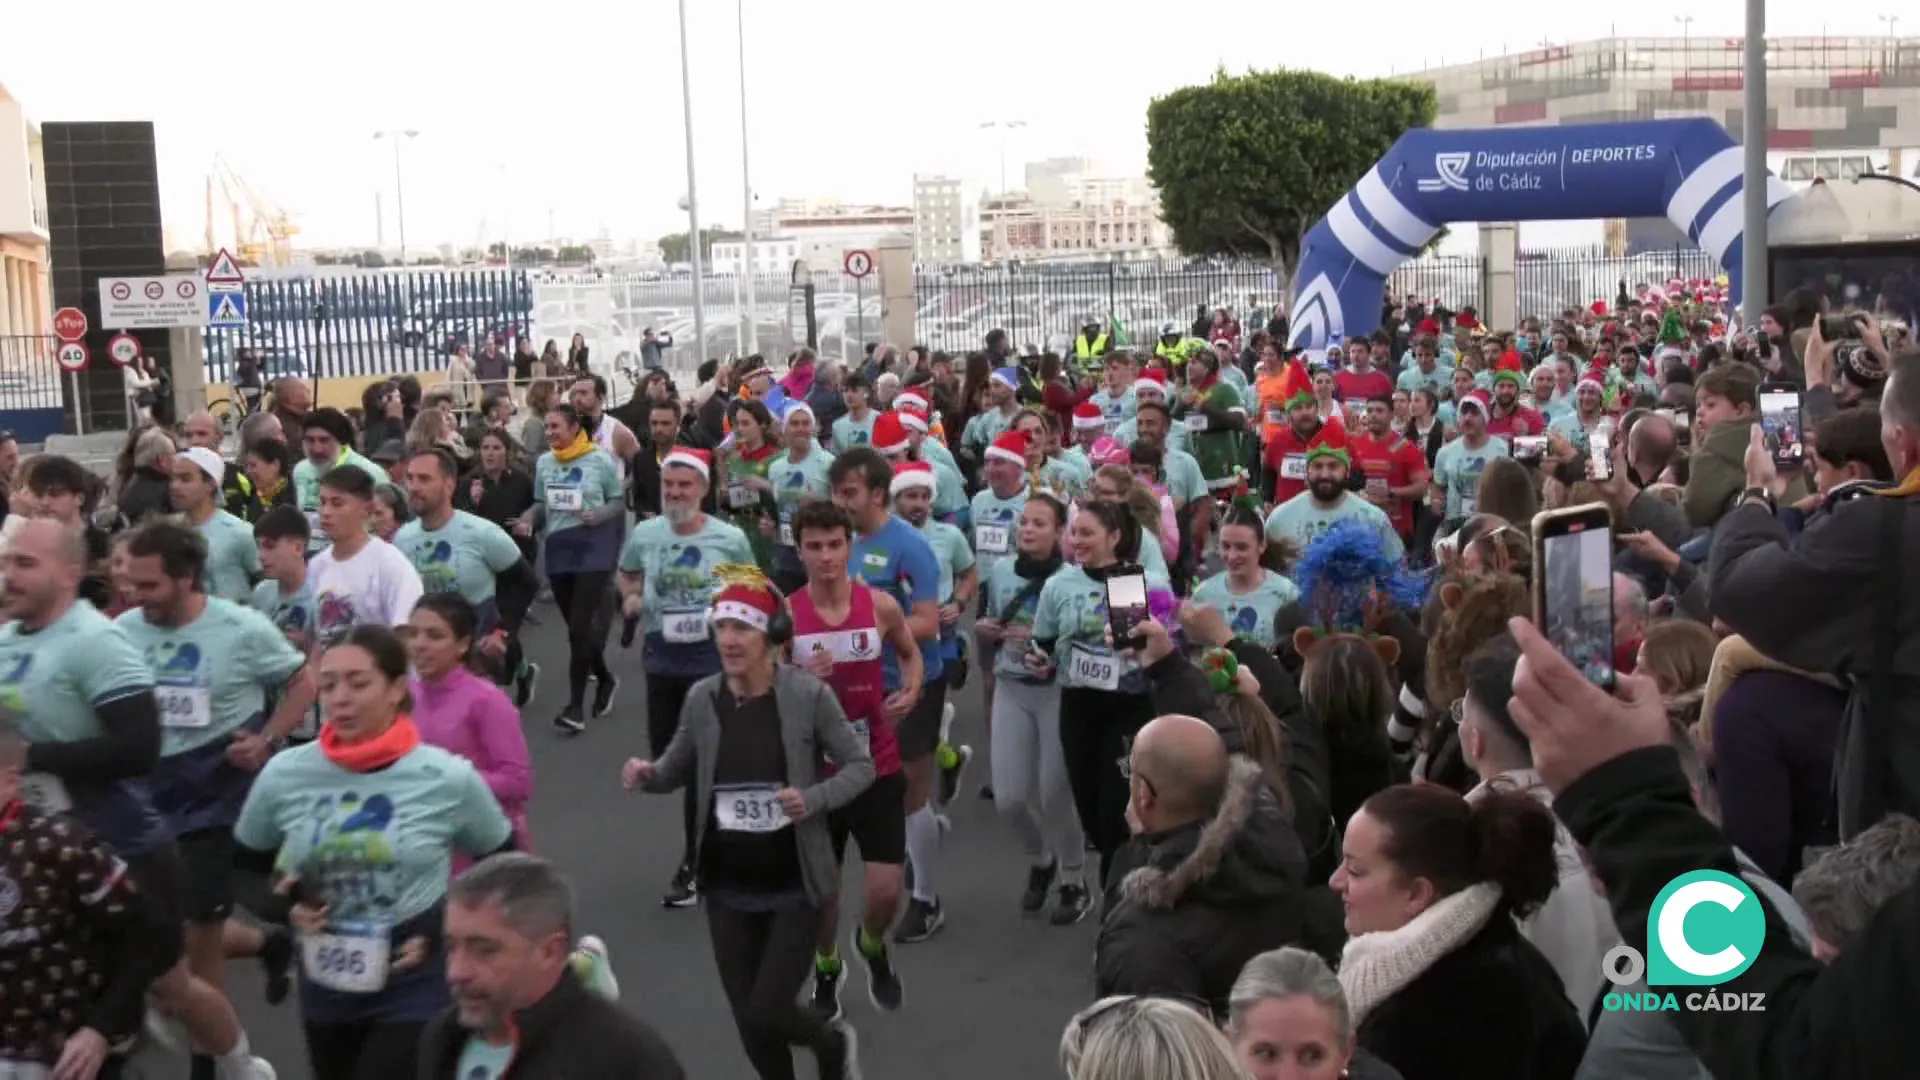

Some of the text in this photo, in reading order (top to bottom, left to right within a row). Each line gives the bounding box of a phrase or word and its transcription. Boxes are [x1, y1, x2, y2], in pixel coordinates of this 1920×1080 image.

[1476, 150, 1556, 168] Diputación
[1572, 145, 1656, 163] DEPORTES
[1476, 173, 1541, 191] de Cádiz
[55, 317, 84, 329] STOP
[62, 350, 83, 361] 40
[1076, 657, 1112, 680] 1059
[735, 799, 774, 820] 931
